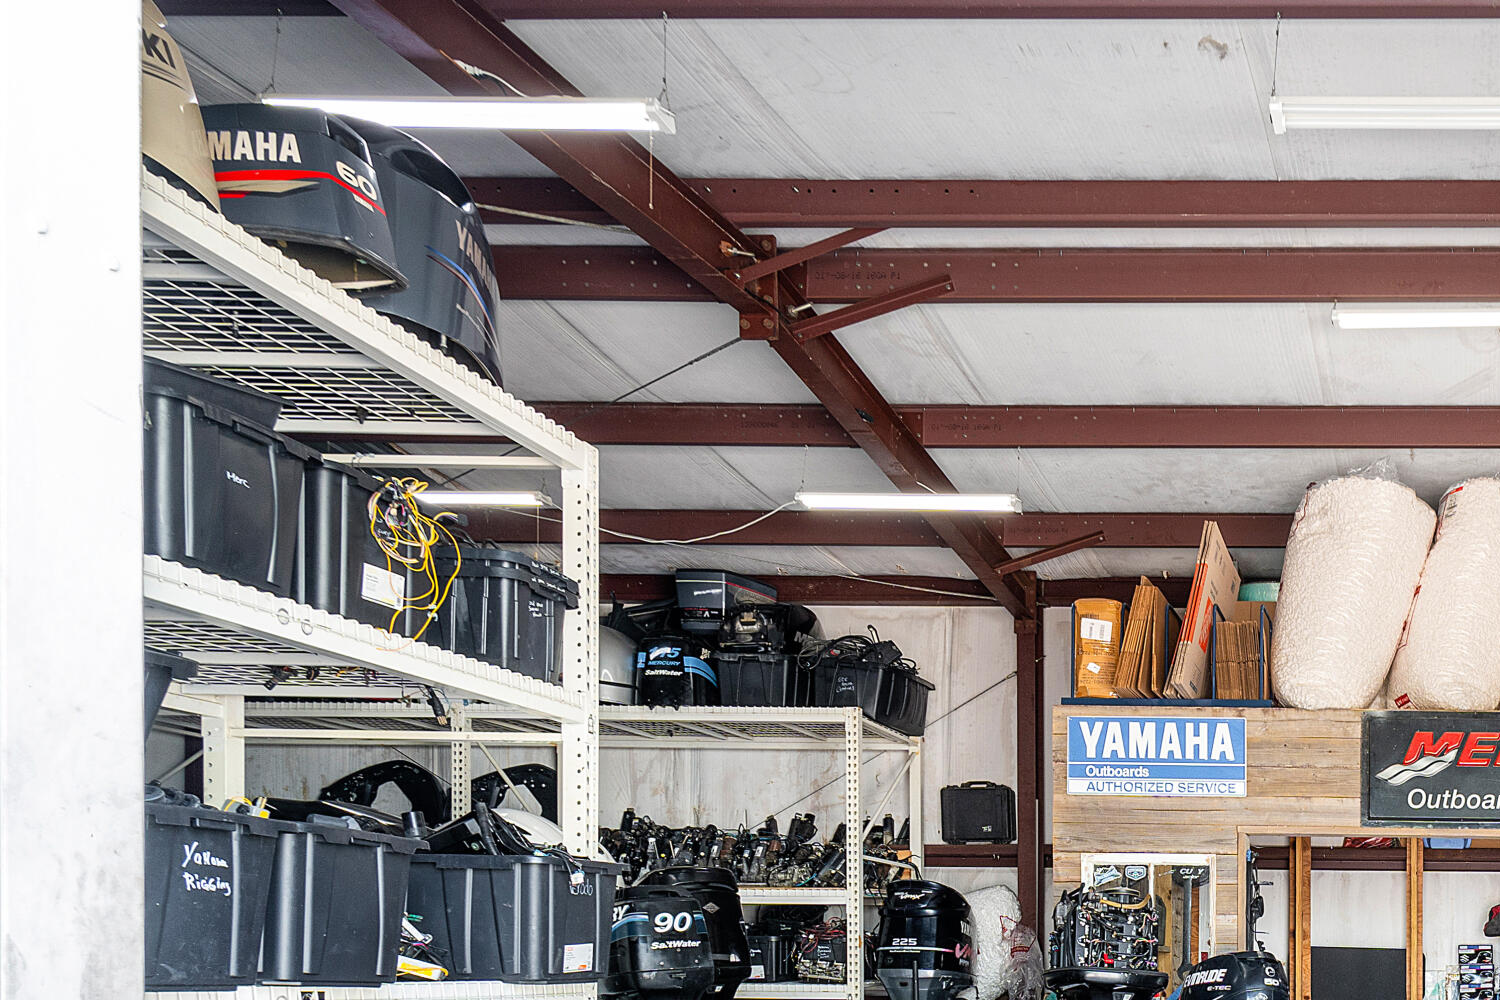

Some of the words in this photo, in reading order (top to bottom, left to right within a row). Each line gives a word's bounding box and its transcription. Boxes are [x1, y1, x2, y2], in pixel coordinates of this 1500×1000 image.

[1079, 721, 1235, 761] YAMAHA
[1085, 765, 1150, 778] Outboards
[1086, 781, 1174, 793] AUTHORIZED
[1177, 783, 1236, 794] SERVICE
[653, 912, 693, 933] 90
[892, 938, 917, 946] 225
